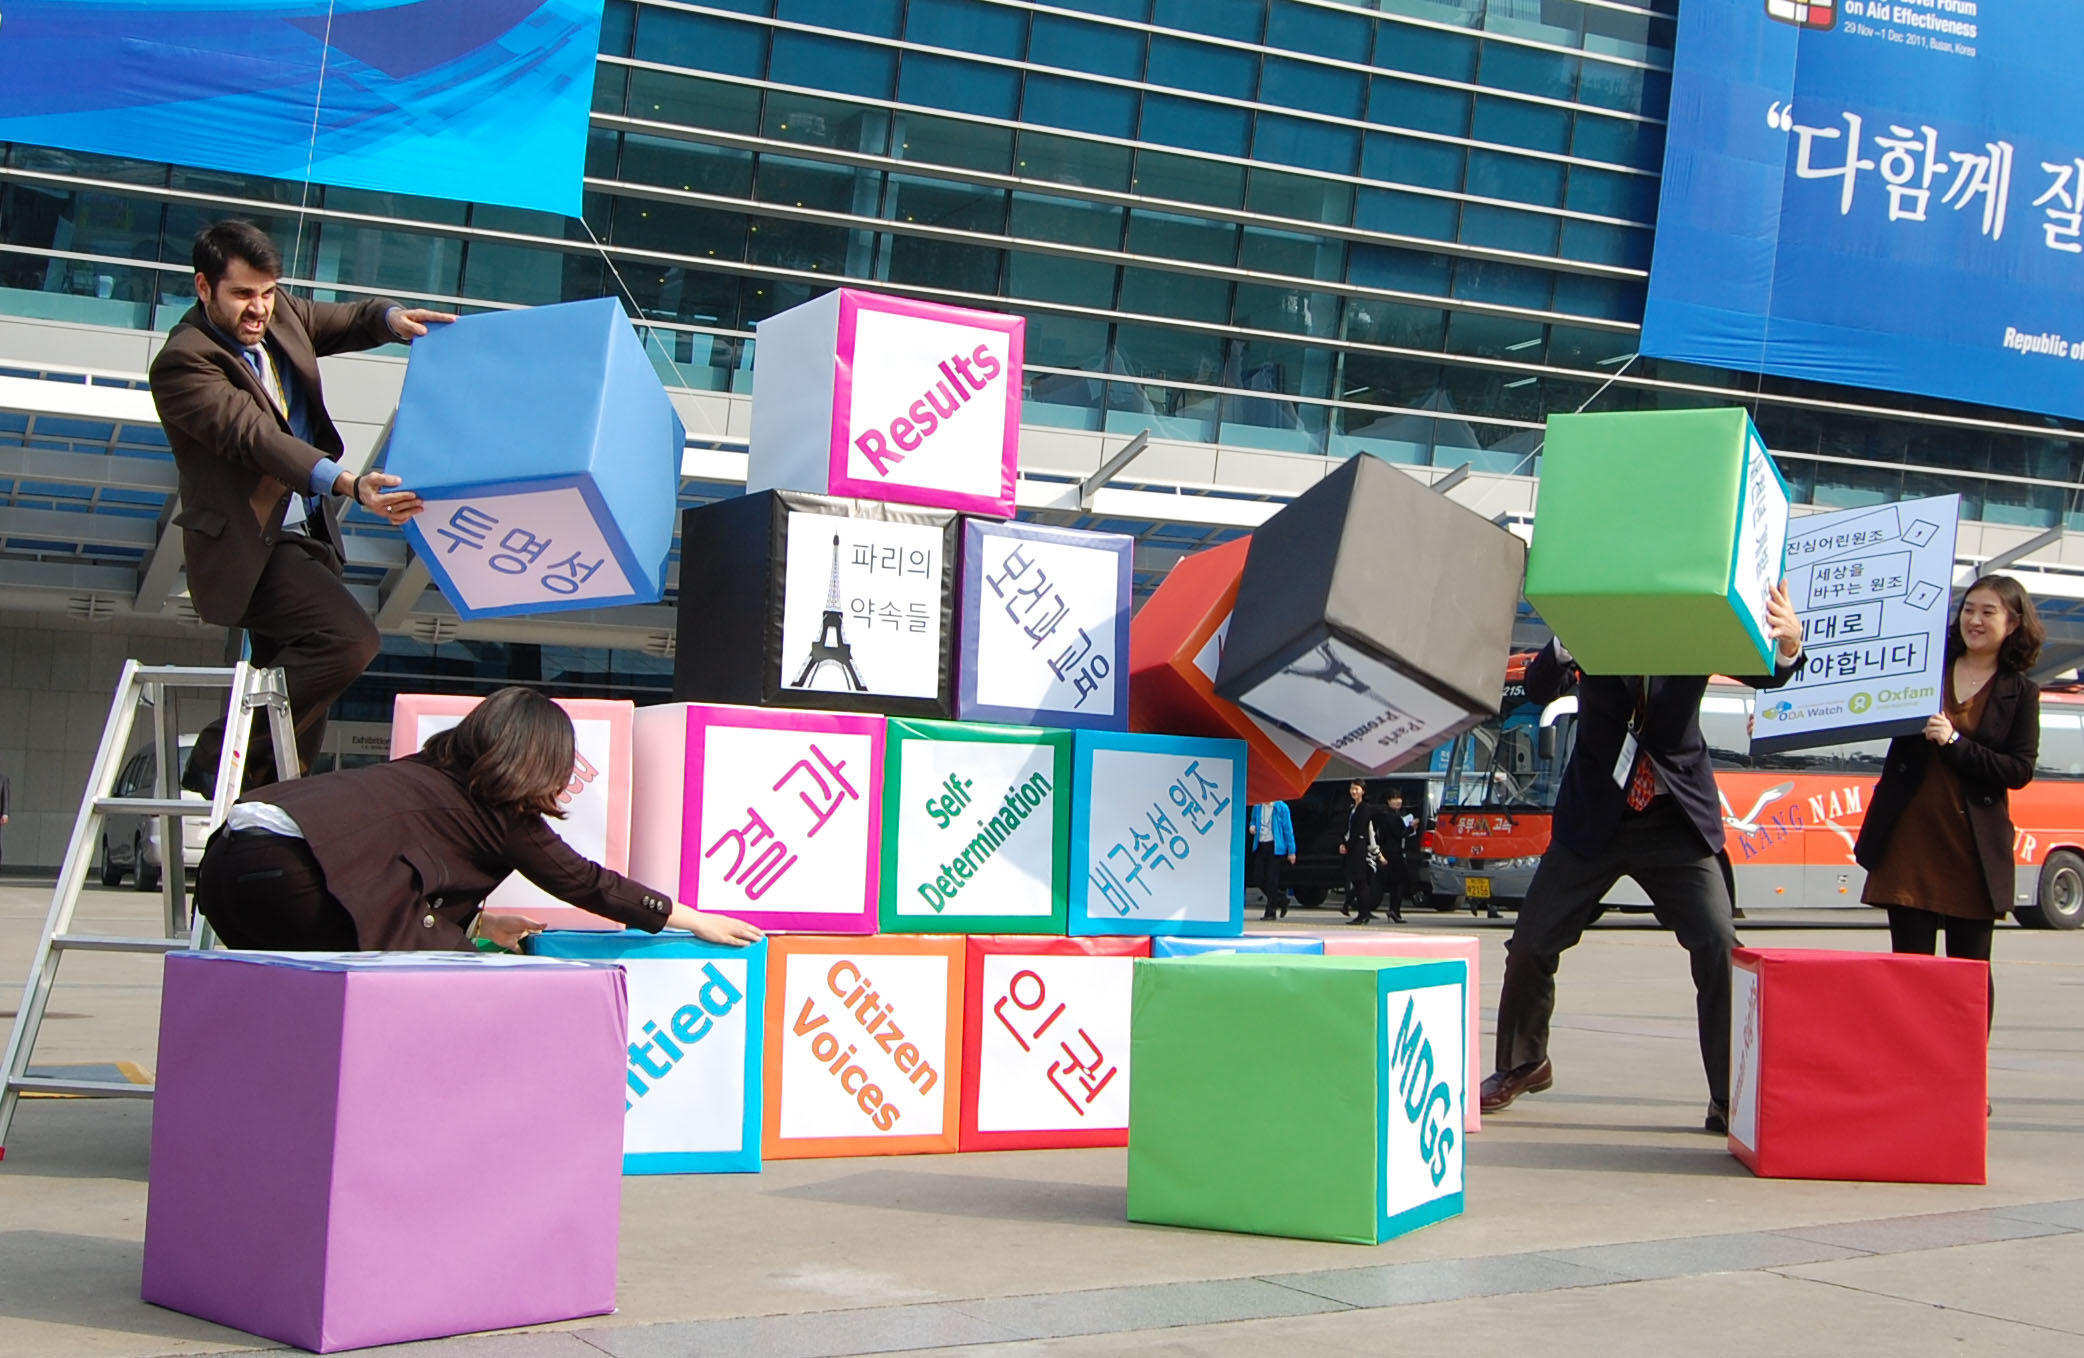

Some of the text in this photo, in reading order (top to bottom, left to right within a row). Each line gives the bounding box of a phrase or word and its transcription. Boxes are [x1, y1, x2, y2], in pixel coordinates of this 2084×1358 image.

[1845, 1, 1977, 38] on Aid Effectiveness
[1937, 0, 1977, 17] Forum
[2003, 326, 2069, 358] Republic
[854, 344, 1001, 477] Results
[437, 505, 605, 595] 투명성
[851, 543, 931, 579] 파리의
[1816, 562, 1865, 582] 세상을
[850, 597, 931, 634] 약속들
[1813, 575, 1903, 600] 바꾸는 원조
[986, 543, 1110, 708] 보건과 교육
[1807, 705, 1844, 719] Watch
[1877, 686, 1935, 704] Oxfam
[704, 744, 860, 901] 결과
[925, 772, 974, 830] Self-
[1738, 785, 1863, 861] KANG NAM
[916, 771, 1053, 914] Determination
[1088, 760, 1231, 917] 비구속성 원조
[826, 959, 940, 1097] Citizen
[994, 969, 1119, 1116] 인권
[792, 996, 901, 1133] Voices
